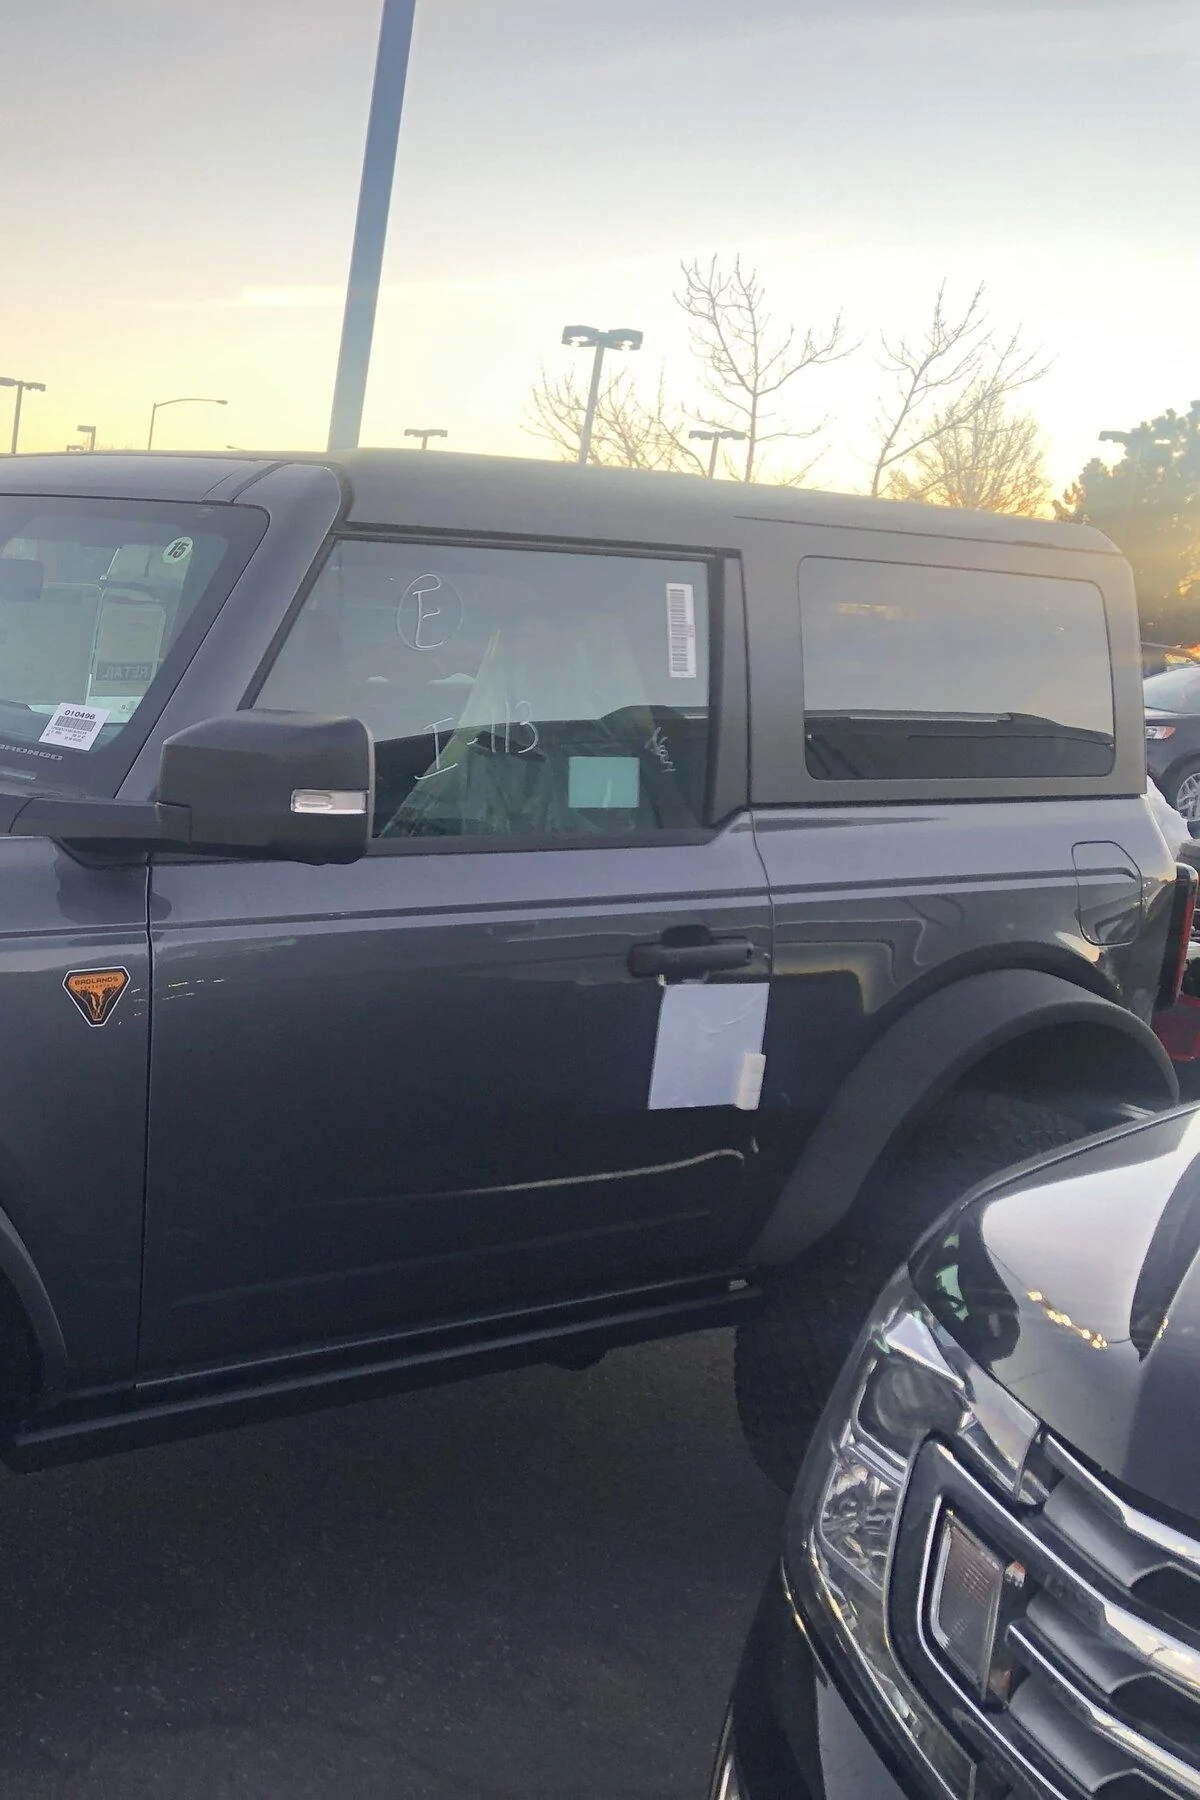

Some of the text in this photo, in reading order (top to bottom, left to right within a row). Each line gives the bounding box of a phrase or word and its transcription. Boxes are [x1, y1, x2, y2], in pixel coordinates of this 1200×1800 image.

[167, 541, 189, 559] 15
[412, 584, 444, 649] E
[64, 709, 96, 720] 010496
[74, 976, 119, 986] BADLANDS
